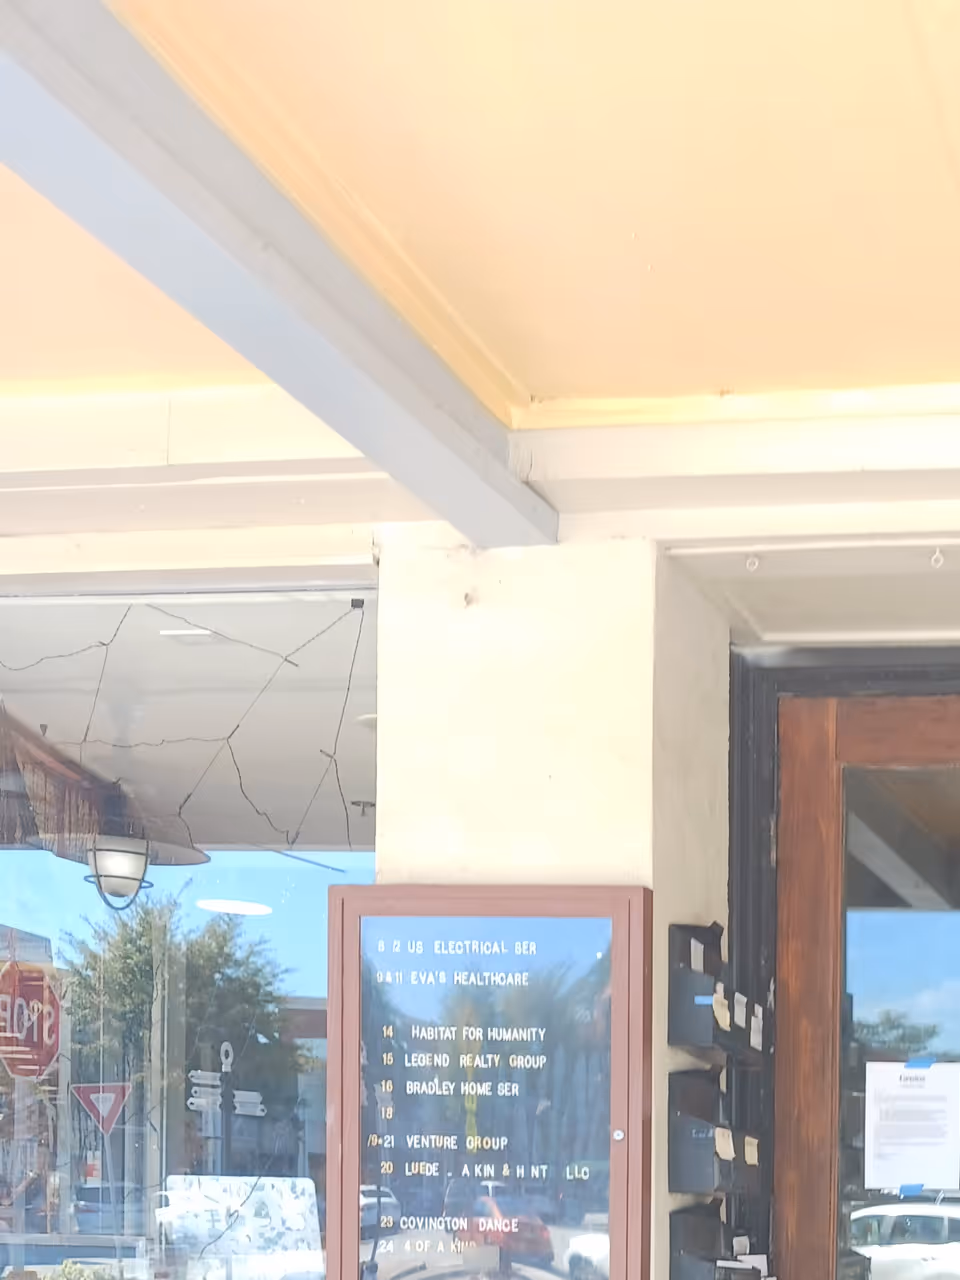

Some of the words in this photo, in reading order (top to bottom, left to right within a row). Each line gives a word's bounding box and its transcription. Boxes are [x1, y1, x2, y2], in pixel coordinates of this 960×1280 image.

[407, 940, 424, 955] US
[434, 940, 509, 955] ELECTRICAL
[514, 941, 537, 956] SER
[410, 970, 447, 986] EVA'S
[453, 971, 529, 986] HEALTHCARE
[382, 1025, 393, 1038] 14
[411, 1024, 457, 1041] HABITAT
[462, 1026, 484, 1041] FOR
[487, 1026, 546, 1042] HUMANITY
[382, 1053, 394, 1066] 15
[404, 1053, 450, 1067] LEGEND
[459, 1054, 501, 1068] REALTY
[508, 1054, 547, 1069] GROUP
[380, 1079, 393, 1092] 16
[406, 1080, 456, 1096] BRADLEY
[460, 1082, 493, 1096] HOME
[497, 1082, 519, 1096] SER
[406, 1134, 458, 1150] VENTURE
[466, 1135, 508, 1150] GROUP
[380, 1160, 394, 1174] 20
[380, 1215, 394, 1228] 23
[400, 1216, 468, 1231] COVINGTON
[478, 1217, 519, 1233] DANCE
[379, 1240, 394, 1253] 24
[415, 1240, 430, 1252] OF
[437, 1240, 445, 1253] A
